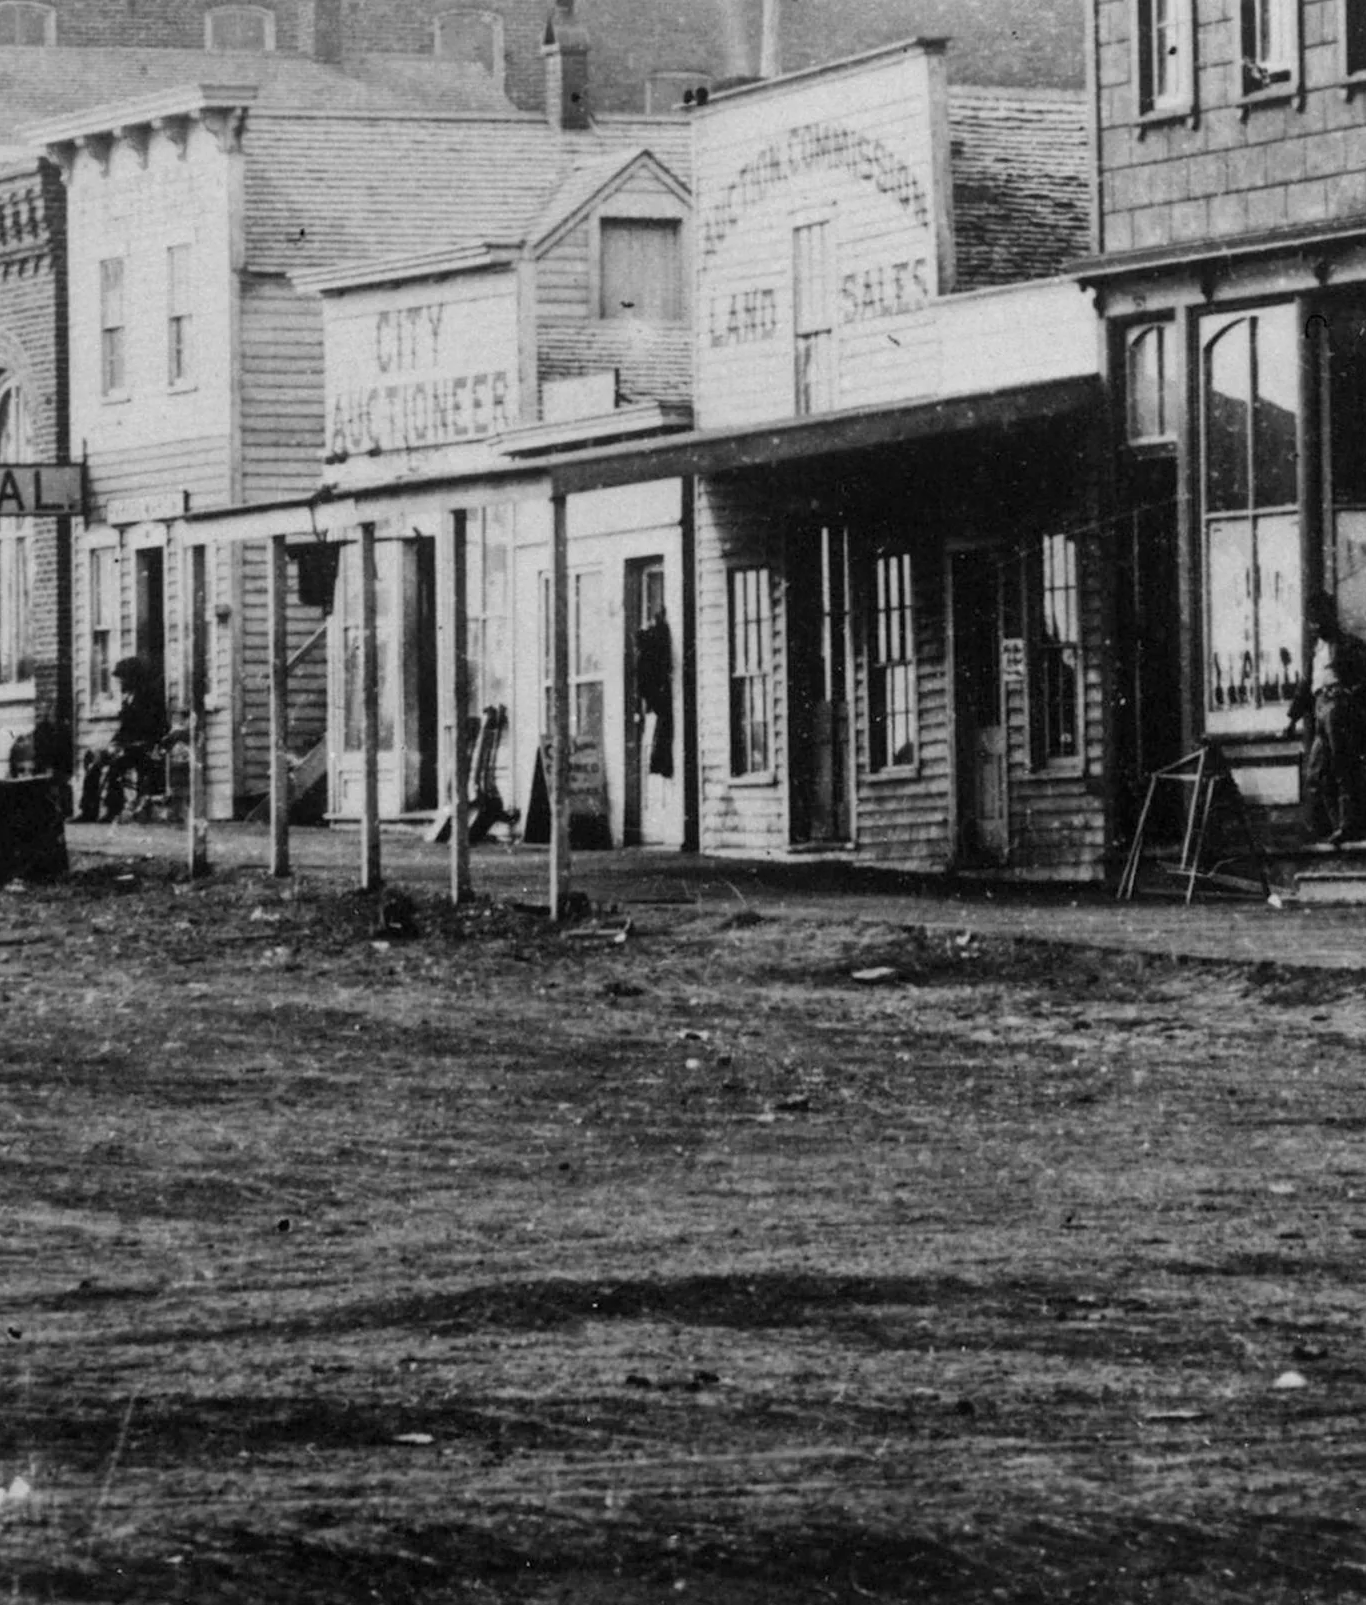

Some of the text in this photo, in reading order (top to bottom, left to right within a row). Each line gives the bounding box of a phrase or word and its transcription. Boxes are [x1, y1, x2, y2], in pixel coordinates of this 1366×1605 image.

[708, 287, 778, 347] LAND
[839, 257, 929, 325] SALES
[376, 302, 444, 373] CITY
[332, 370, 510, 453] AUCTIONEER
